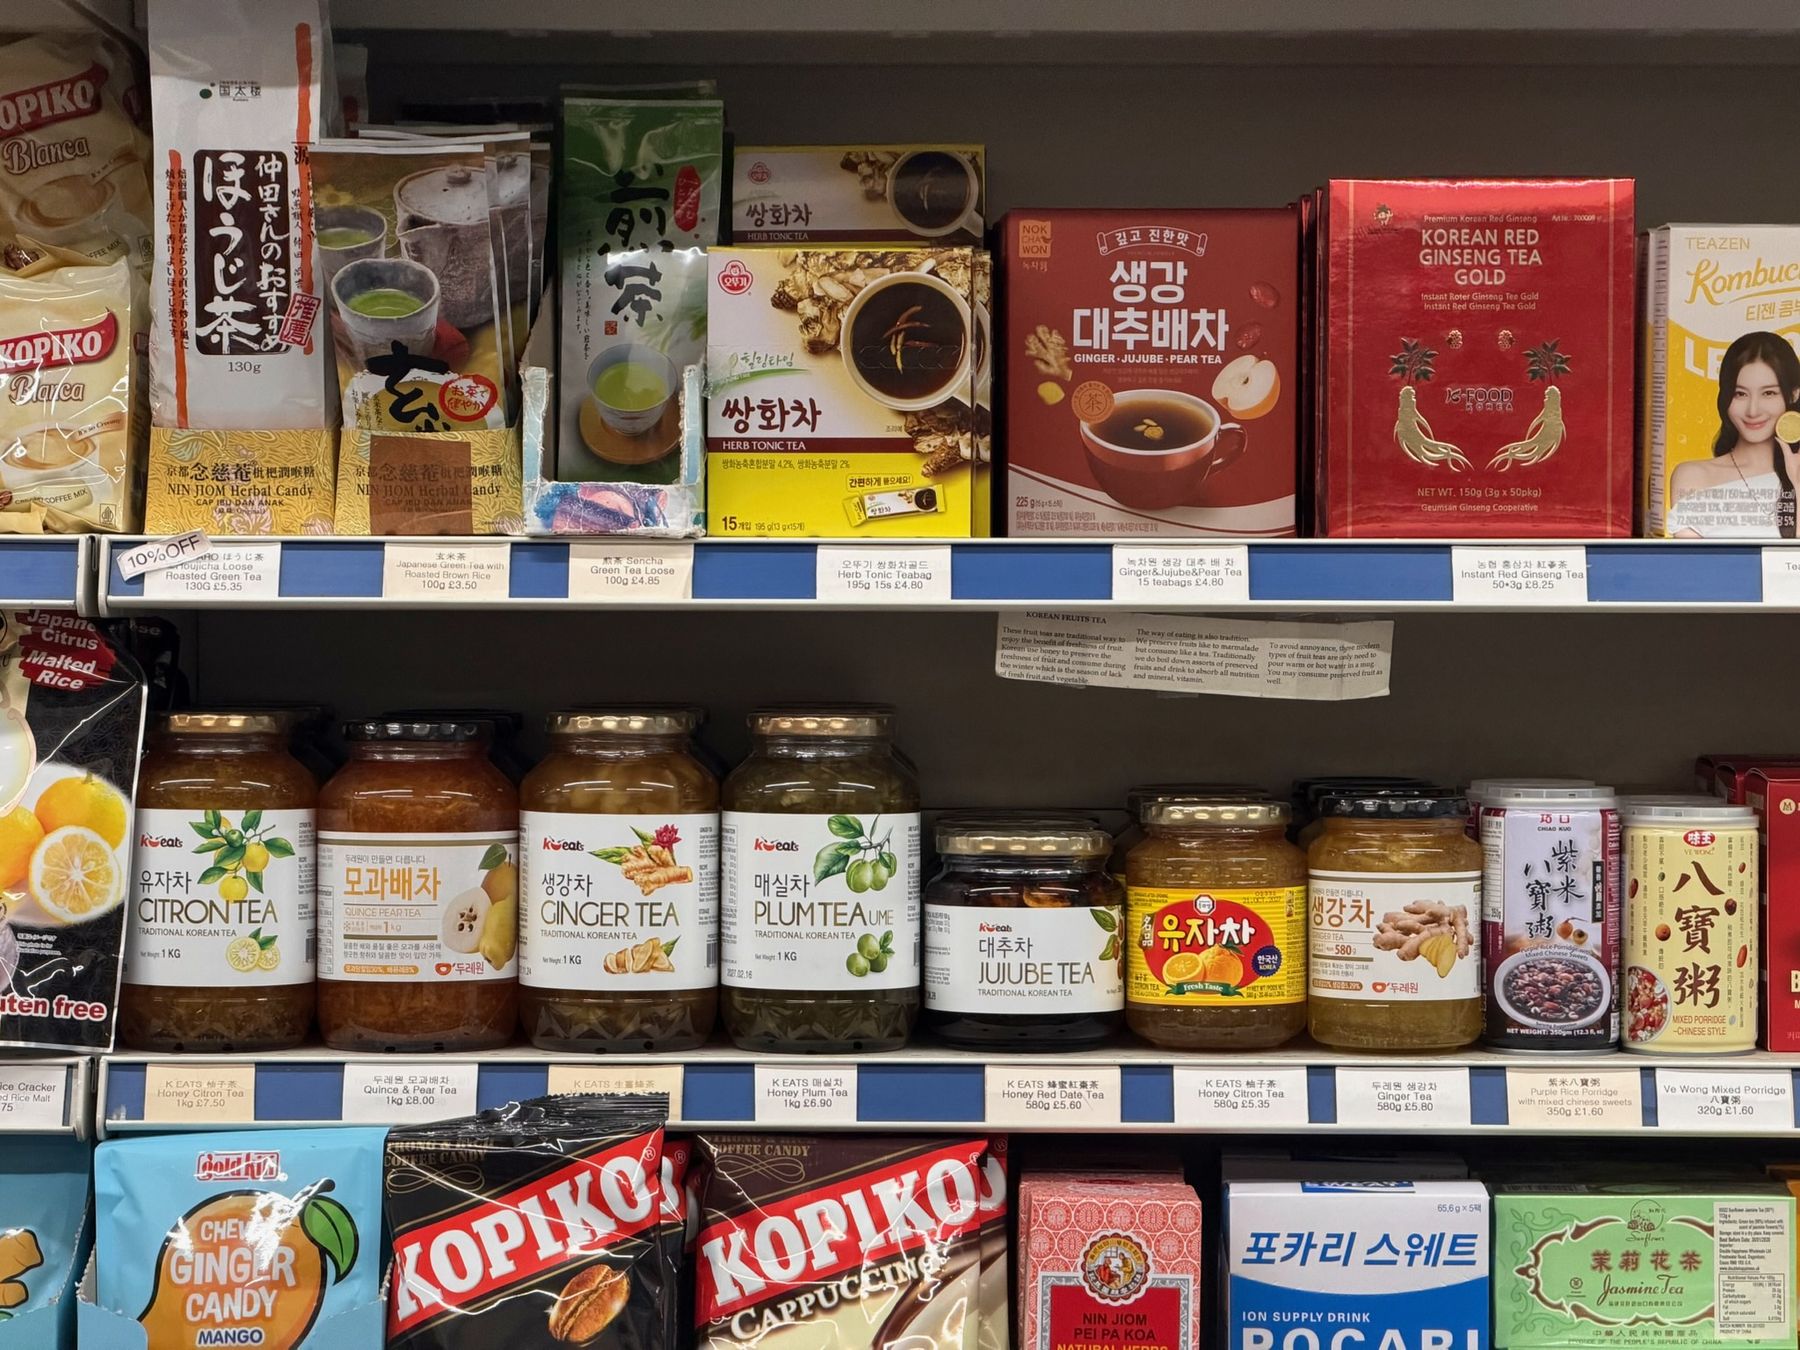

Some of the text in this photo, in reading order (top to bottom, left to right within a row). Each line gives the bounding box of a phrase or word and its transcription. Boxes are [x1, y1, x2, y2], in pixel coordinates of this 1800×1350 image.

[2, 136, 89, 175] Blanca
[746, 203, 812, 227] 쌍화차
[1421, 229, 1539, 245] KOREAN RED
[1685, 237, 1750, 250] TEAZEN
[196, 152, 263, 354] ほうじ茶
[255, 153, 290, 352] 仲田さんのおすすめ
[1419, 248, 1543, 266] GINSENG TEA
[1110, 260, 1188, 303] 생강
[1454, 269, 1506, 285] GOLD
[1685, 258, 1800, 306] Kombuc
[1073, 307, 1229, 351] 대추배차
[0, 330, 102, 370] KOPIKO
[1074, 354, 1222, 364] GINGER JUJUBE PEAR TEA
[228, 361, 262, 374] 130g
[9, 374, 84, 405] Blanca
[722, 396, 822, 433] 쌍화차
[722, 441, 806, 450] HERB TONIC TEA
[167, 483, 314, 499] NIN JIOM Herbal Candy
[128, 535, 200, 568] 10%OFF
[436, 552, 466, 560] 玄米茶
[396, 561, 504, 570] Japanese Green Tea with
[626, 557, 663, 565] Sencha
[842, 560, 872, 569] 오뚜기
[166, 572, 262, 581] Roasted Green Tea
[405, 570, 491, 579] Roasted Brown Rice
[590, 566, 675, 575] Green Tea Loose
[838, 570, 932, 580] Herb Tonic Teabag
[1461, 571, 1584, 579] Instant Red Ginseng Tea
[185, 582, 242, 591] 130G £5.35
[422, 581, 477, 590] 100g £3.50
[605, 576, 660, 585] 100g £4.85
[847, 581, 923, 590] 195g 15s £4.80
[1525, 580, 1554, 590] £8.25
[1025, 611, 1107, 625] KOREAN FRUITS TEA
[41, 628, 99, 650] Citrus
[26, 650, 96, 674] Malted
[36, 670, 84, 690] Rice
[1687, 831, 1715, 846] 味王
[1551, 839, 1585, 904] 紫米
[139, 870, 192, 895] 유자차
[344, 867, 441, 901] 모과배차
[541, 873, 592, 898] 생강차
[755, 873, 810, 898] 매실차
[138, 899, 278, 924] CITRON TEA
[541, 900, 680, 927] GINGER TEA
[755, 901, 894, 927] PLUM TEA UME
[1312, 895, 1374, 929] 생강차
[1157, 914, 1255, 953] 유자차
[1672, 861, 1725, 1009] 八寶粥
[979, 937, 1033, 959] 대추차
[455, 962, 484, 975] 두레원
[978, 962, 1095, 985] JUJUBE TEA
[1390, 982, 1419, 994] 두레원
[54, 995, 106, 1020] free
[1673, 1015, 1726, 1025] MIXED PORRIDGE
[373, 1076, 450, 1085] 두레원 모과배차
[772, 1079, 843, 1087] K EATS 매실차
[1372, 1082, 1437, 1091] 두레원 생강차
[364, 1086, 457, 1094] Quince & Pear Tea
[767, 1088, 848, 1098] Honey Plum Tea
[1002, 1090, 1104, 1100] Honey Red Date Tea
[1378, 1092, 1432, 1101] Ginger Tea
[1530, 1088, 1618, 1097] Purple Rice Porridge
[1664, 1085, 1786, 1095] Ve Wong Mixed Porridge
[386, 1096, 435, 1105] 1kg £8.00
[784, 1099, 833, 1108] 1kg £6.90
[1026, 1101, 1081, 1110] 580g £5.60
[1377, 1102, 1433, 1112] 580g £5.80
[1547, 1107, 1603, 1117] 350g £1.60
[1697, 1106, 1754, 1116] 320g £1.60
[710, 1144, 811, 1157] COFFEE CANDY
[396, 1156, 652, 1321] KOPIKO
[703, 1159, 976, 1307] KOPIKO
[1241, 1231, 1479, 1268] 포카리 스웨트
[170, 1245, 296, 1287] GINGER
[1590, 1249, 1702, 1273] 茉莉花茶
[731, 1253, 949, 1340] CAPPUCCINO
[1597, 1274, 1684, 1305] Jasmine Tea
[186, 1287, 279, 1323] CANDY
[1083, 1314, 1147, 1324] NIN JIOM
[1242, 1312, 1371, 1322] ION SUPPLY DRINK
[198, 1329, 264, 1345] MANGO
[1074, 1329, 1156, 1341] PEI PA KOA
